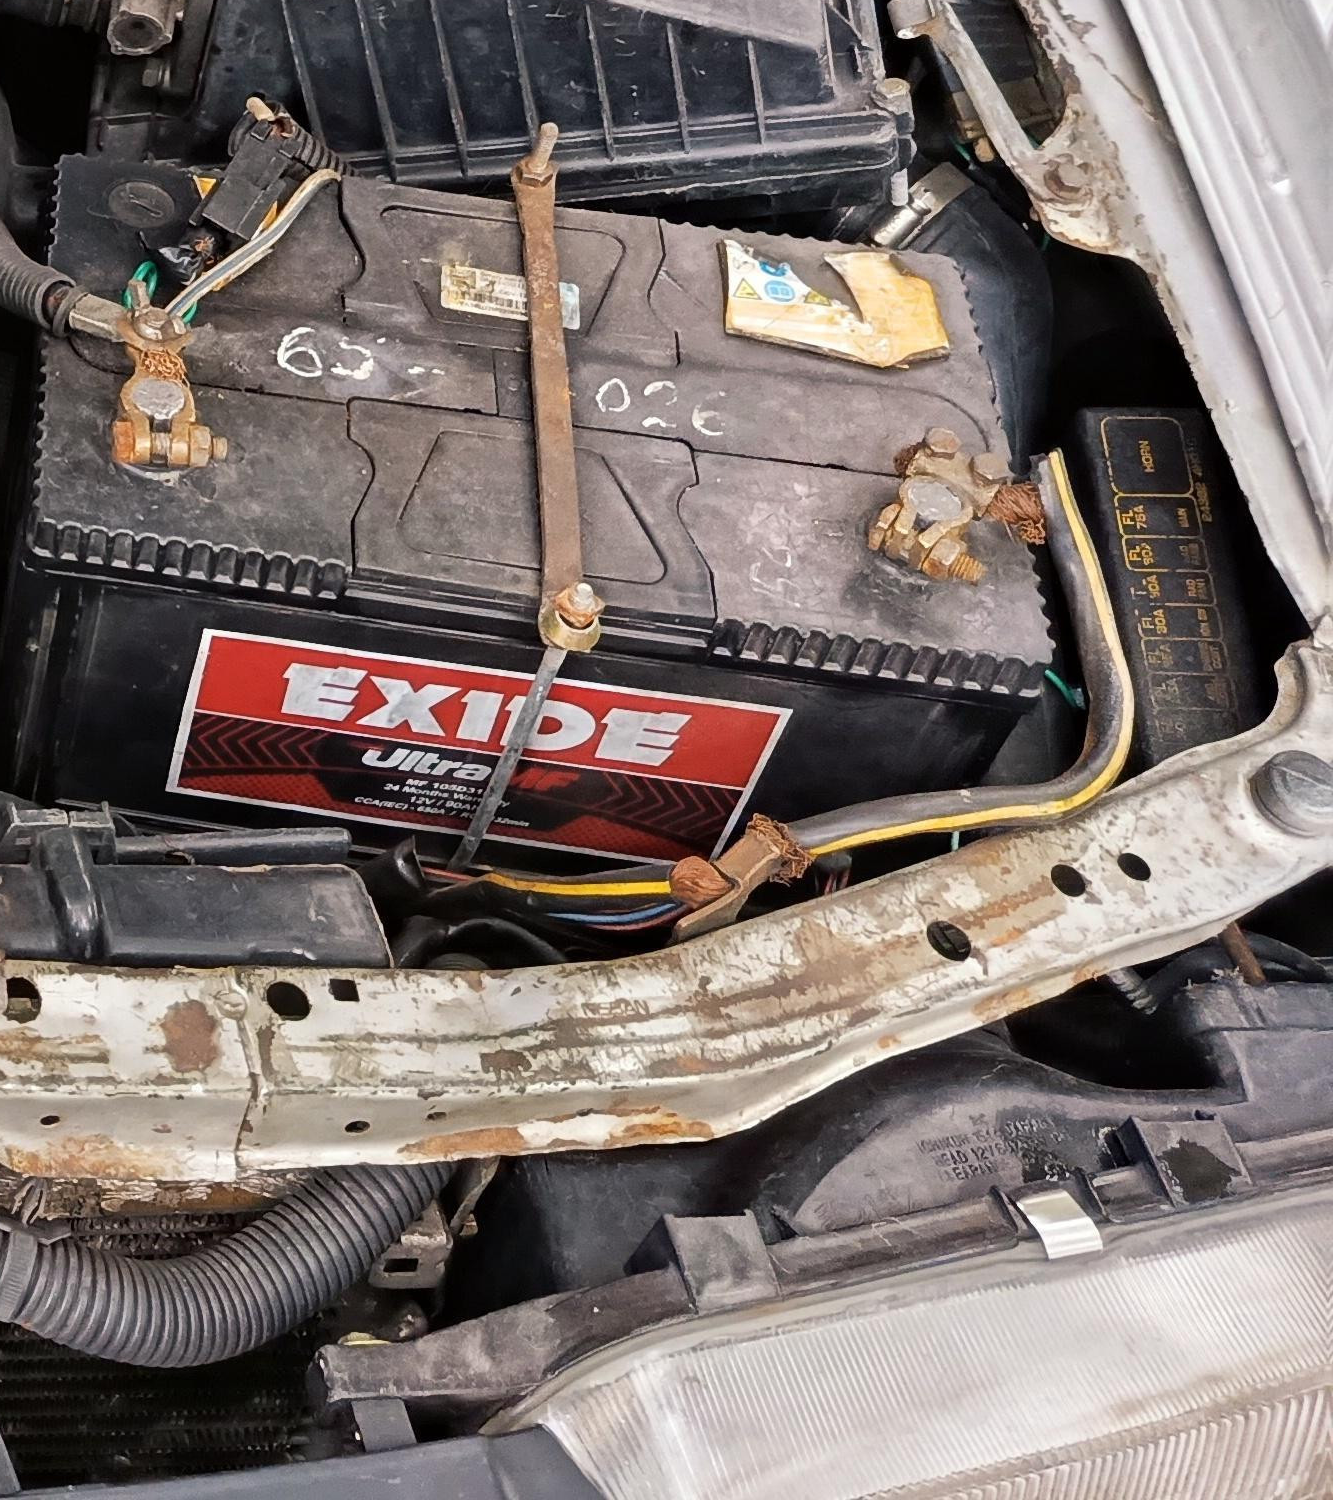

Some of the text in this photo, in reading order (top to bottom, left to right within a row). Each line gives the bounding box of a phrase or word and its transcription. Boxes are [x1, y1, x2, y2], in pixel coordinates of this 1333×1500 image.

[1138, 440, 1155, 473] HORN
[281, 662, 692, 767] EXIDE
[362, 747, 492, 781] Ultra
[401, 785, 449, 798] Months
